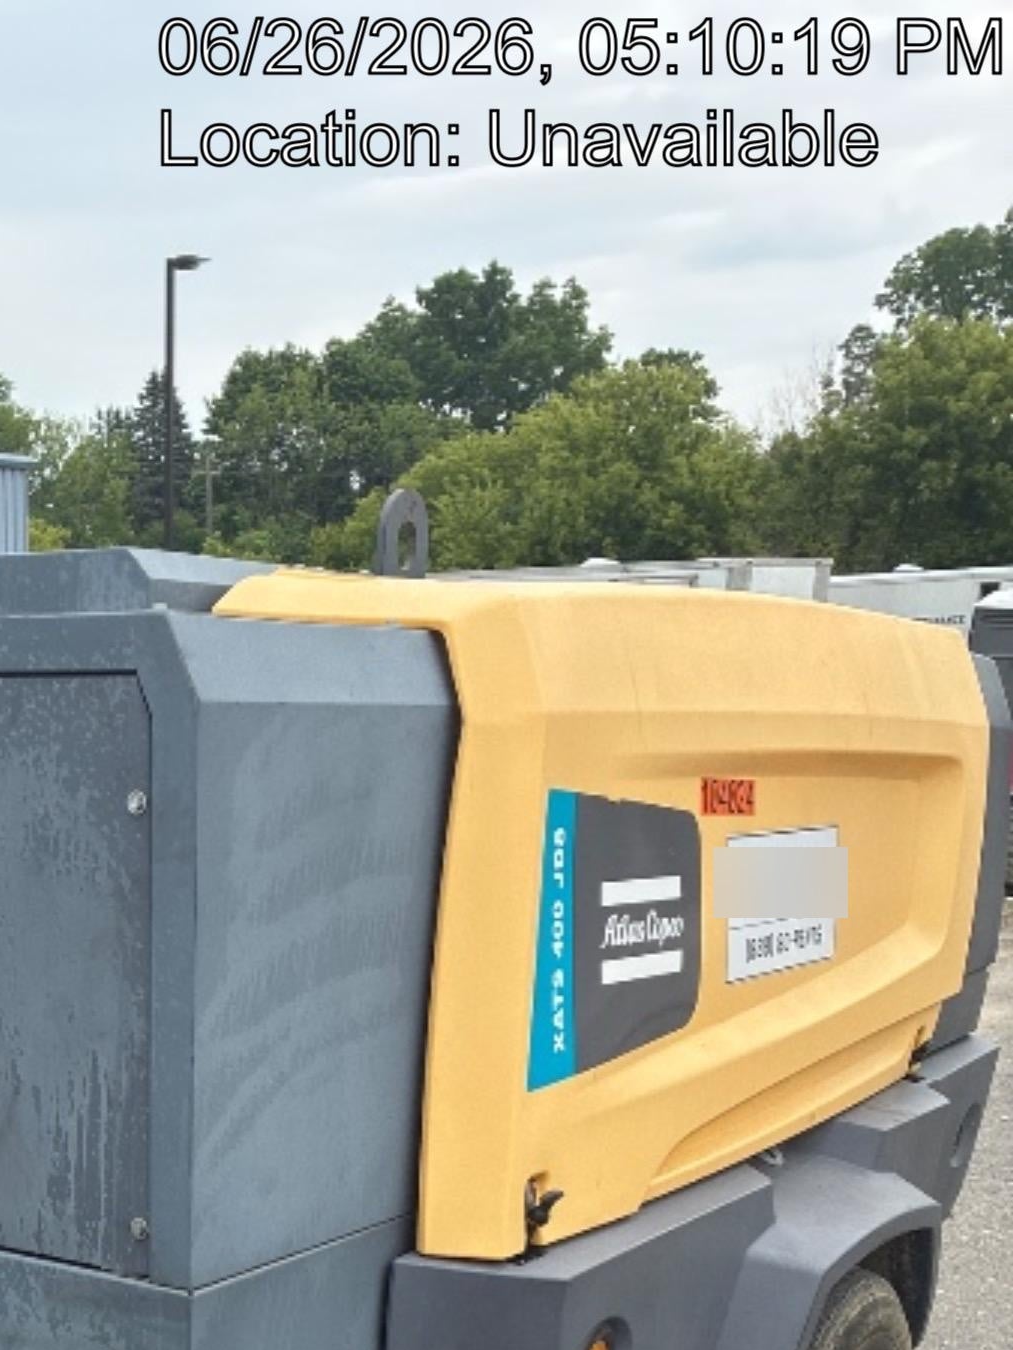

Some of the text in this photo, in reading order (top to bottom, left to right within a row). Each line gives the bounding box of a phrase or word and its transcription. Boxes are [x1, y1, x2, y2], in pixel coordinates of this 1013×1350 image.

[552, 900, 564, 959] 400
[600, 908, 685, 948] Atlas Copco
